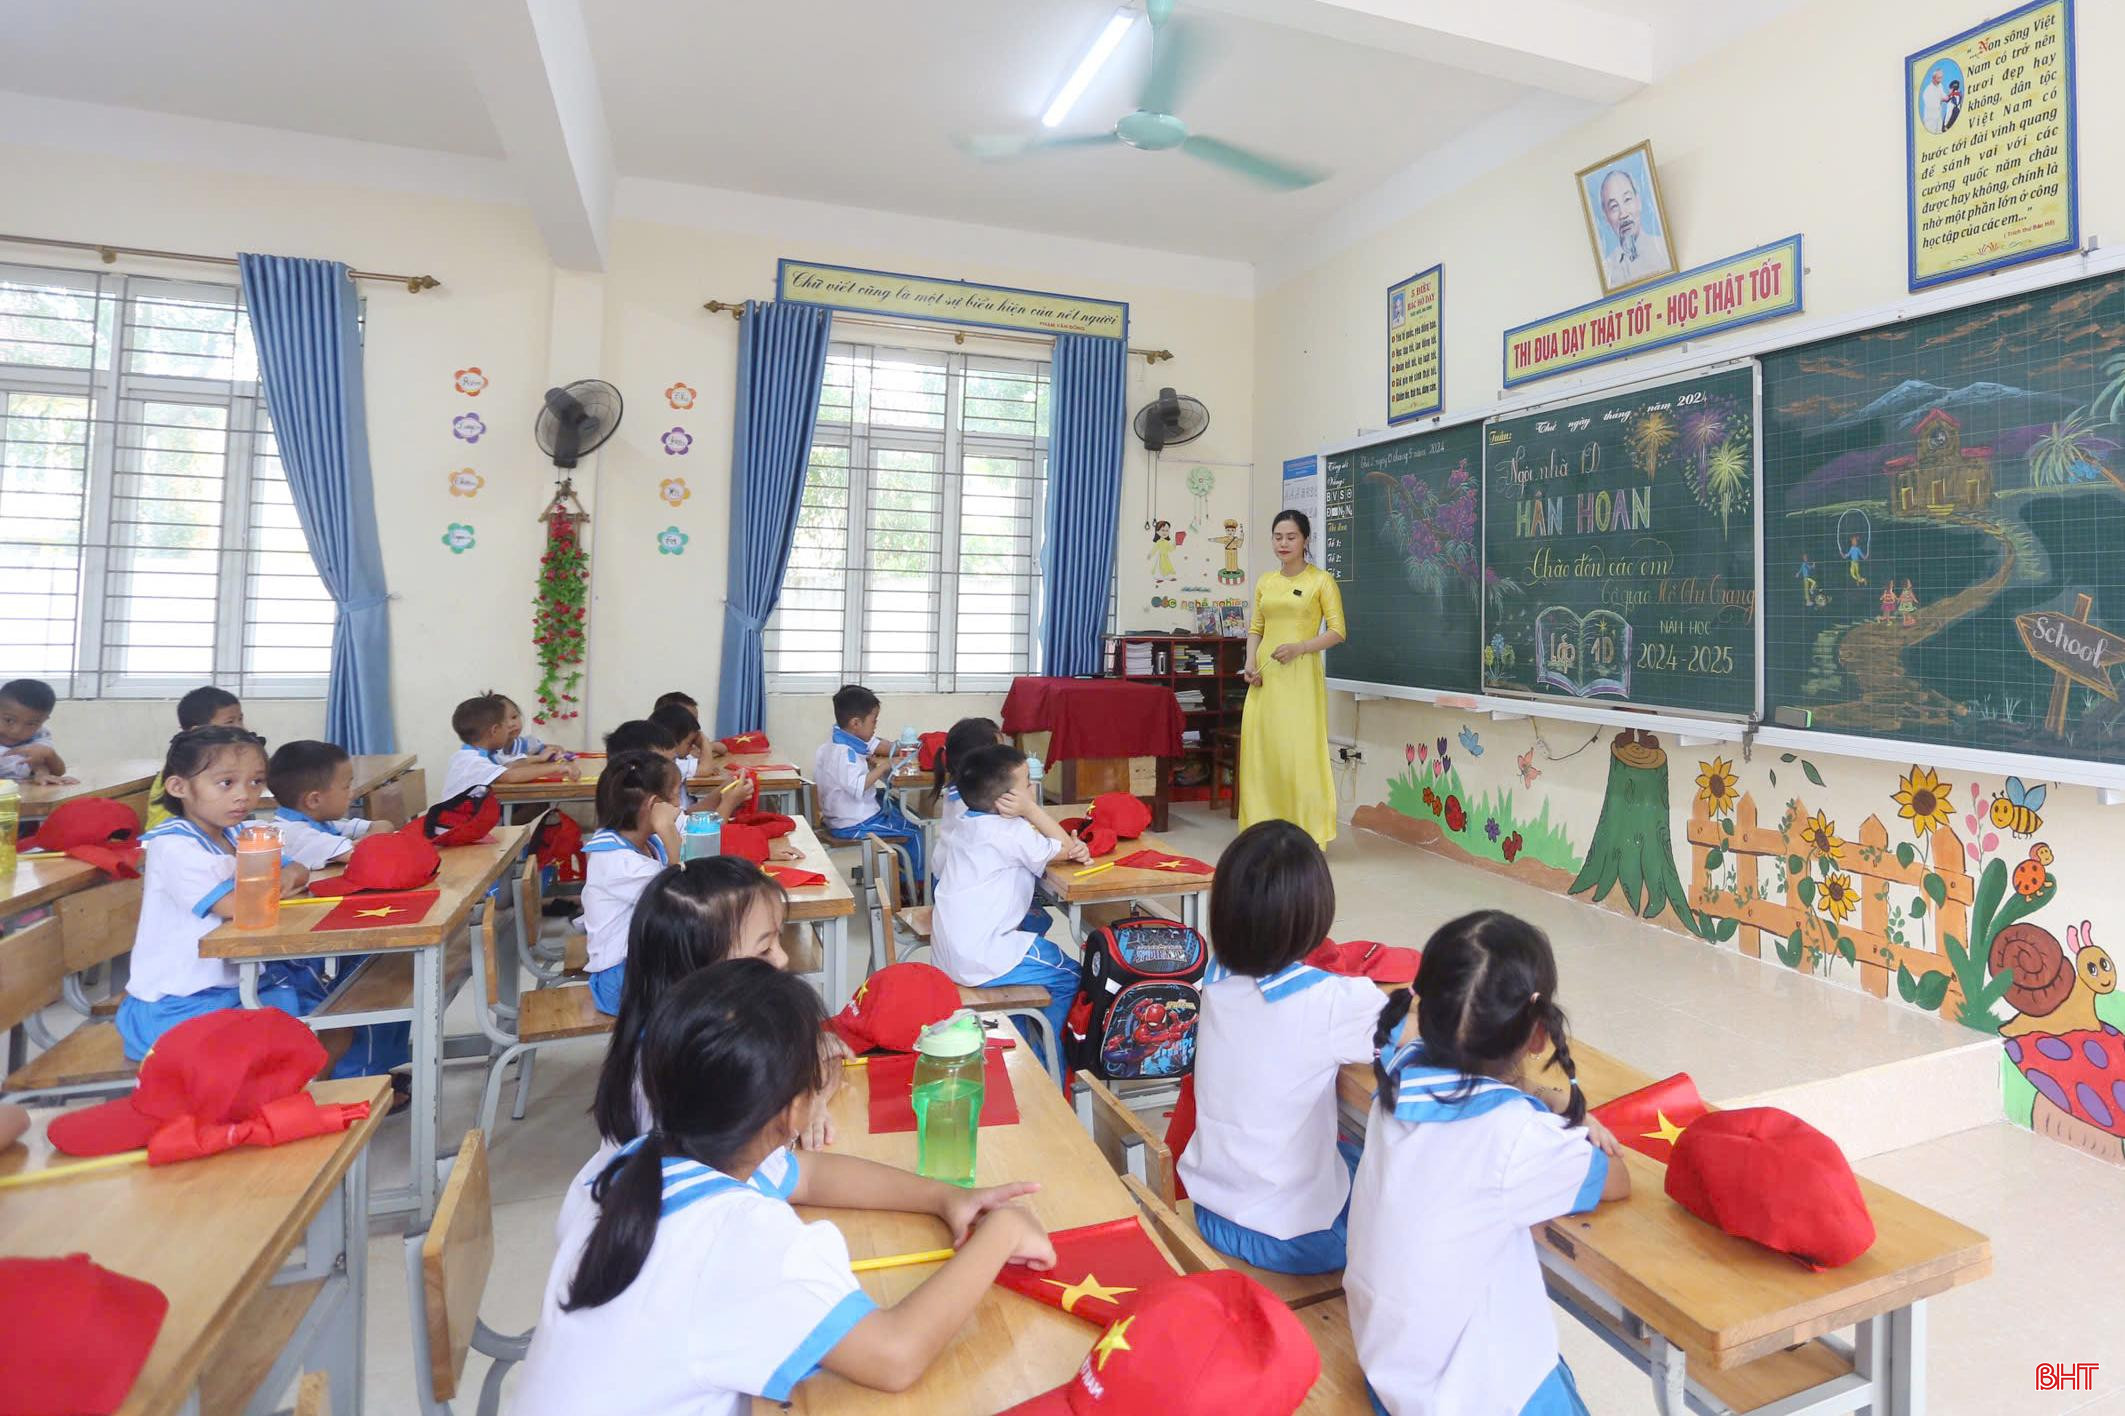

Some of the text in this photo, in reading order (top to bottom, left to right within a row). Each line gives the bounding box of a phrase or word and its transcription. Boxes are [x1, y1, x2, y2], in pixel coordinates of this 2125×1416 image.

[2003, 27, 2030, 45] sông
[2034, 14, 2056, 31] Việt
[1967, 33, 2056, 77] Nam có trở nên
[1967, 52, 2056, 95] tươi đẹp hay
[1967, 70, 2057, 112] không, dân tộc
[1968, 86, 2057, 128] Việt Nam có
[1921, 107, 2057, 163] bước tới đài vinh quang
[1921, 125, 2059, 180] để sánh vai với các
[1921, 145, 2058, 197] cường quốc năm châu
[1922, 161, 2058, 214] được hay không, chính là
[1922, 182, 2059, 232] nhờ một phần lớn ở công
[1922, 235, 1942, 249] học
[1942, 229, 1960, 245] tập
[1960, 223, 1980, 239] của
[1981, 216, 2001, 232] các
[792, 270, 1118, 326] Chữ viết cũng là một sự biểu hiện của nết người
[1513, 341, 1531, 369] THI
[1534, 332, 1558, 363] ĐUA
[1562, 322, 1586, 357] DẠY
[1590, 310, 1623, 347] THẬT
[1627, 298, 1652, 336] TỐT
[1667, 288, 1698, 327] HỌC
[1703, 272, 1744, 315] THẬT
[1750, 257, 1782, 302] TỐT
[1536, 420, 1557, 433] Thứ
[1568, 416, 1590, 431] ngày
[1603, 407, 1631, 421] tháng
[1647, 402, 1671, 413] năm
[1540, 448, 1568, 479] nhà
[1516, 486, 1651, 537] HÂN HOAN
[1526, 546, 1669, 582] Chào đón các em
[2033, 616, 2108, 669] School
